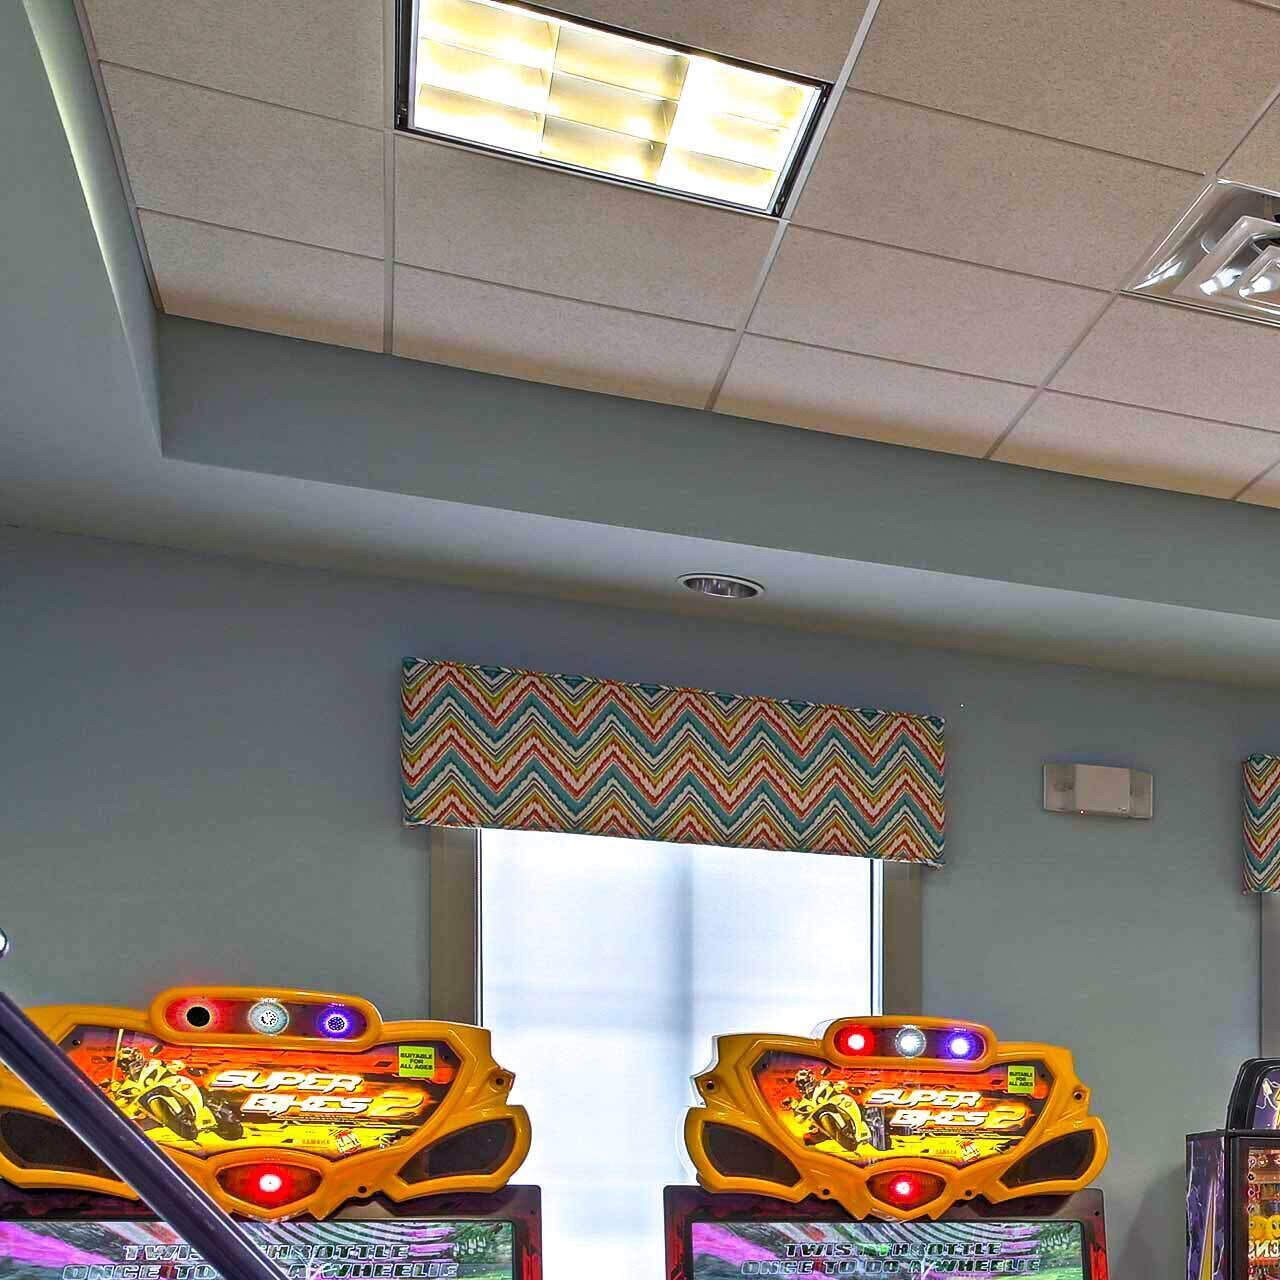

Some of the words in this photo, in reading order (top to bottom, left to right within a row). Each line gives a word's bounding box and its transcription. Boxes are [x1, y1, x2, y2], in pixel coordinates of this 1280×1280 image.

[211, 1069, 363, 1093] SUPER
[241, 1093, 373, 1115] BIKES
[369, 1091, 425, 1119] 2
[869, 1088, 983, 1109] SUPER
[890, 1109, 989, 1129] BIKES
[985, 1105, 1026, 1130] 2
[258, 1244, 410, 1261] HROTTLE
[62, 1264, 161, 1280] ONCE
[741, 1260, 813, 1275] ONCE
[824, 1259, 858, 1274] TO
